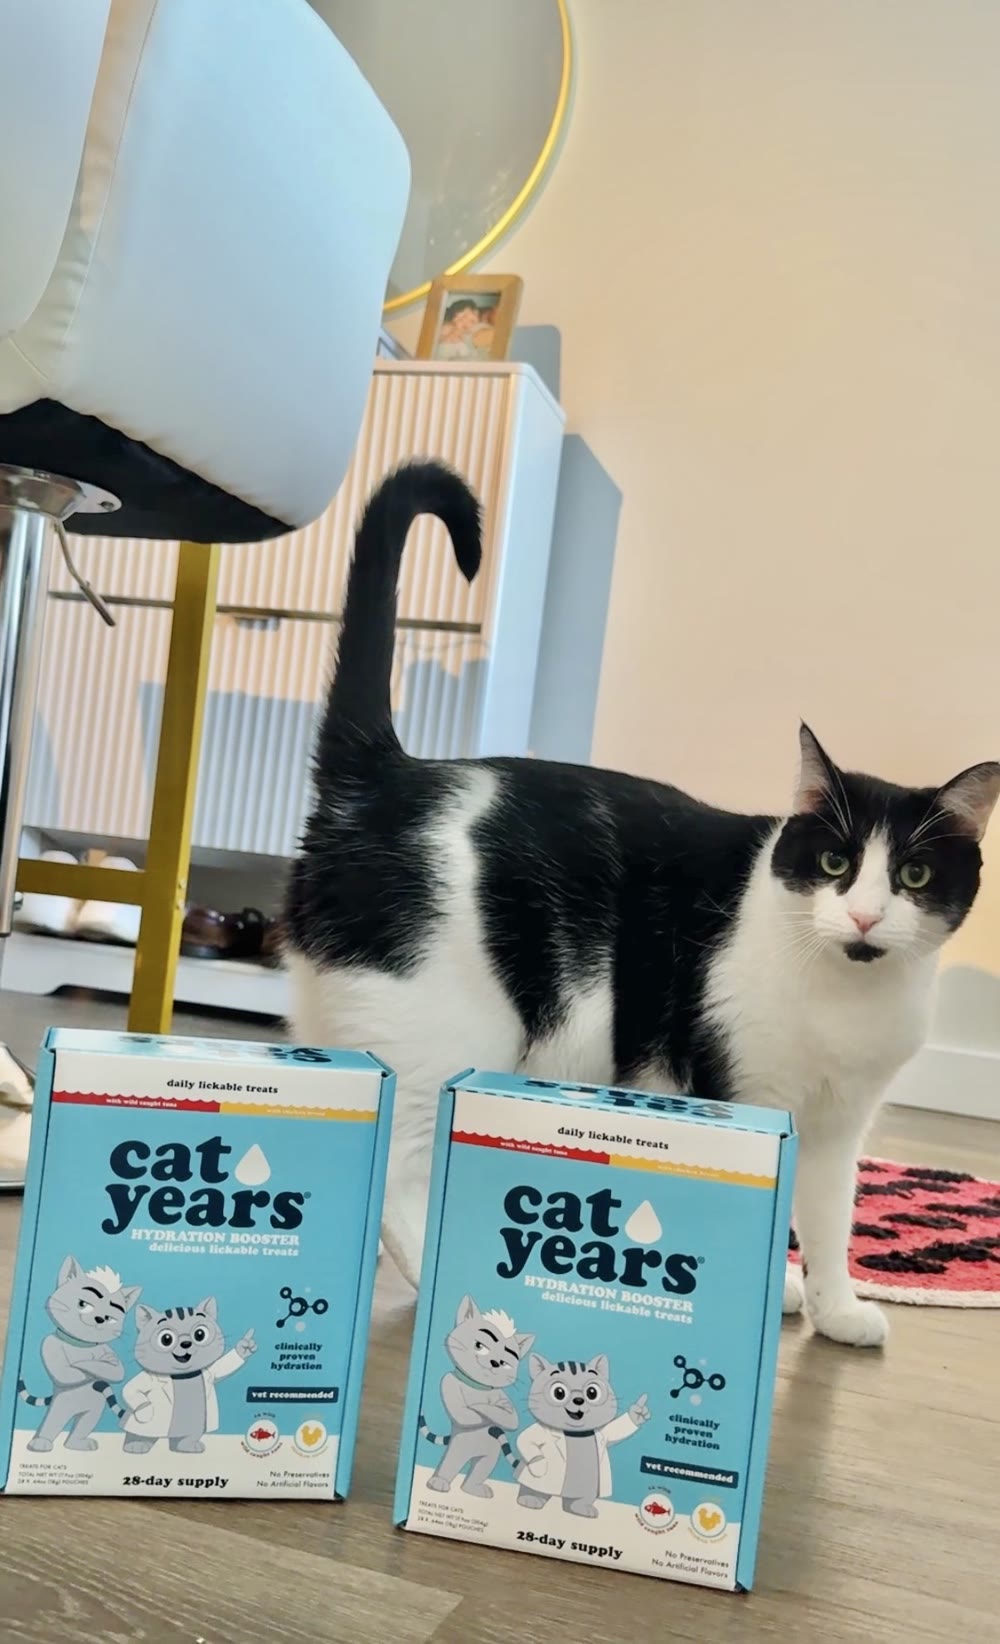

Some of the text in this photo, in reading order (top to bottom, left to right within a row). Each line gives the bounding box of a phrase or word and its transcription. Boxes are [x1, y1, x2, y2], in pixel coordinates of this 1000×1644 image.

[166, 1079, 279, 1094] daily lickable treats
[557, 1126, 669, 1150] daily lickable treats
[109, 1135, 232, 1184] cat
[503, 1184, 622, 1238] cat
[130, 1228, 299, 1246] HYDRATION BOOSTER
[149, 1242, 299, 1257] delicious lickable treats
[524, 1275, 694, 1313] HYDRATION BOOSTER
[541, 1291, 694, 1325] delicious lickable treats
[274, 1342, 323, 1352] clinically
[279, 1353, 316, 1361] proven
[270, 1362, 322, 1371] hydration
[269, 1391, 334, 1399] recommended
[668, 1414, 720, 1431] clinically
[674, 1426, 713, 1439] proven
[664, 1433, 720, 1450] hydration
[284, 1470, 330, 1478] Preservatives
[645, 1462, 734, 1483] vet recommended
[122, 1475, 229, 1489] 28-day supply
[256, 1480, 268, 1488] No
[270, 1480, 301, 1488] Artificial
[516, 1531, 623, 1560] 28-day supply
[665, 1550, 729, 1568] No Preservatives
[651, 1558, 728, 1579] No Artificial Flavors
